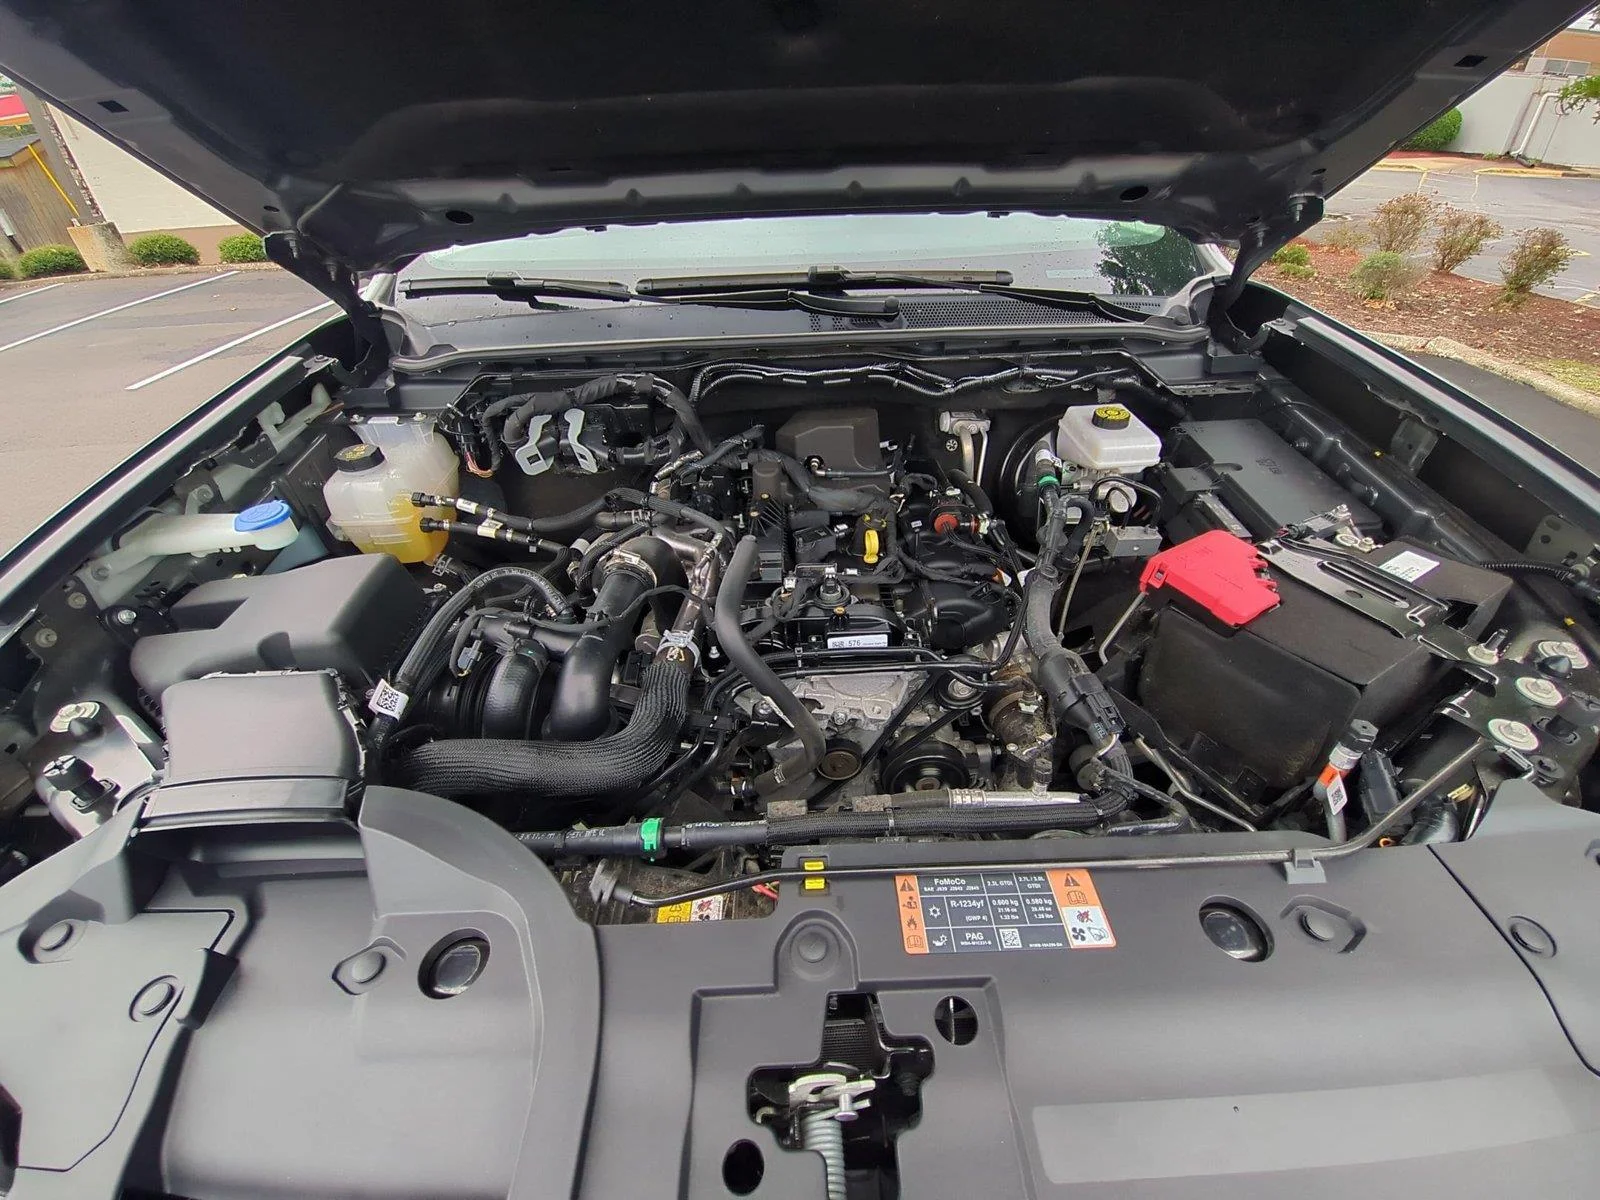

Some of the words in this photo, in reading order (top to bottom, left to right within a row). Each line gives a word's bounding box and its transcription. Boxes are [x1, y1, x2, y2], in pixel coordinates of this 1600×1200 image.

[934, 877, 966, 886] FoMoCo
[950, 900, 984, 909] R-1234yf
[1010, 899, 1019, 907] kg
[1043, 898, 1053, 906] kg
[965, 932, 984, 941] PAG
